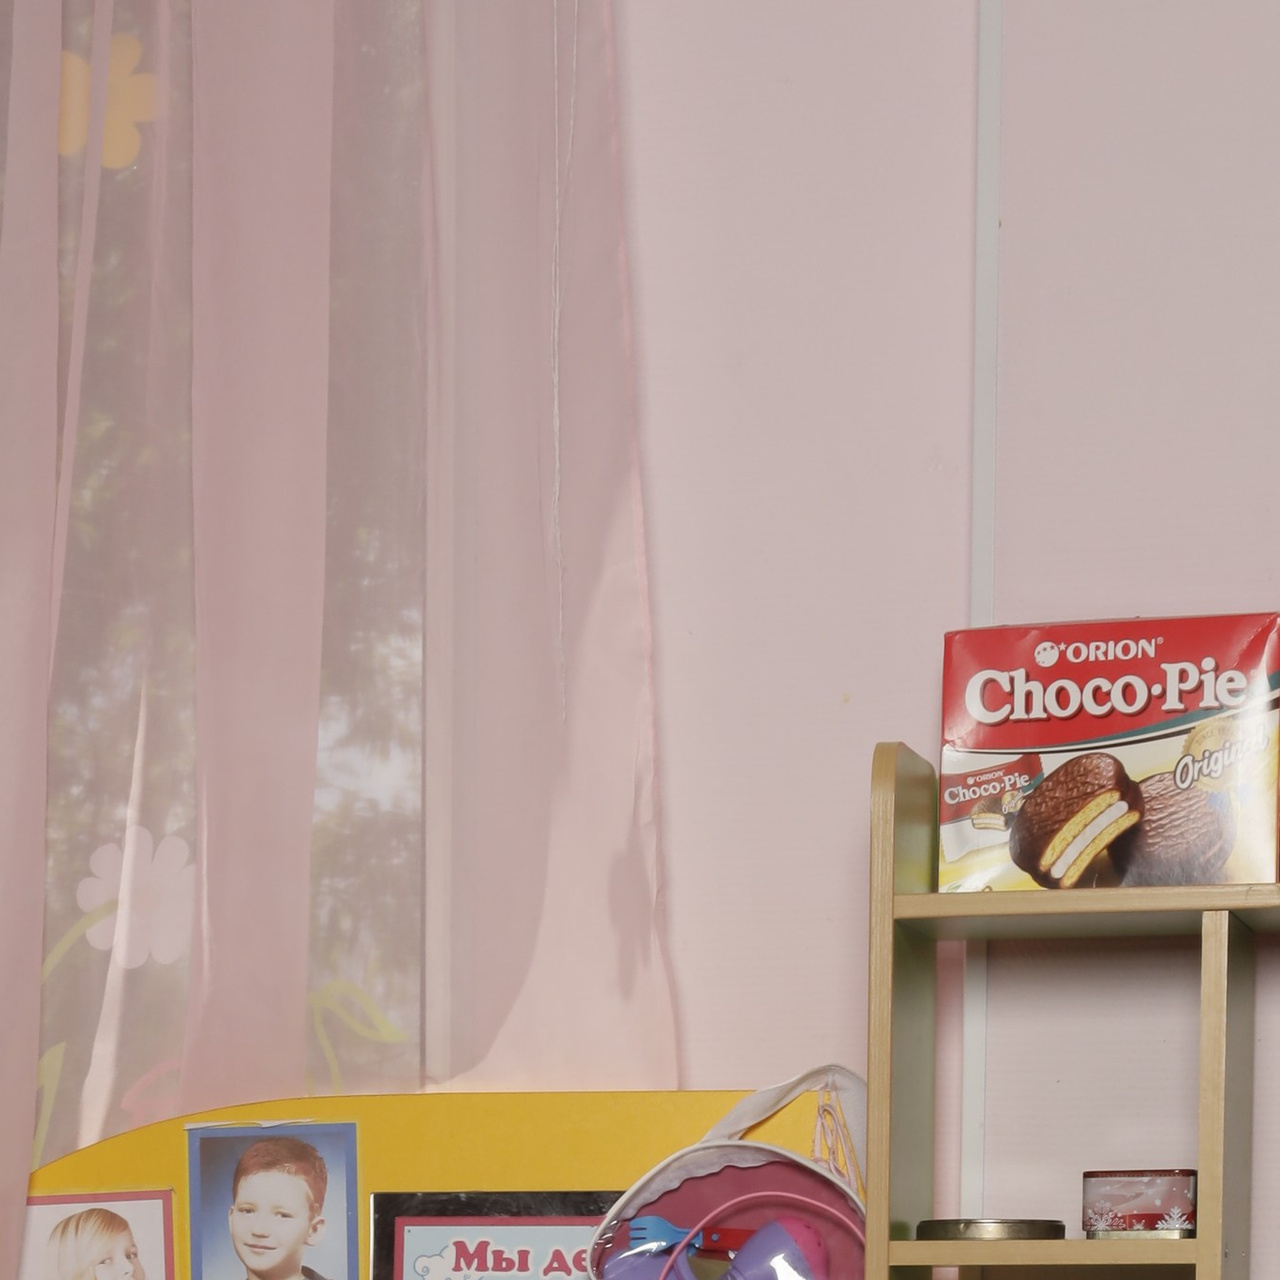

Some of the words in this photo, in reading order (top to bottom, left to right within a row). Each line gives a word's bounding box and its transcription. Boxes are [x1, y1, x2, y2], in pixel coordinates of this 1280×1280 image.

[1066, 637, 1157, 664] ORION
[1174, 724, 1269, 790] Originl
[452, 1240, 530, 1273] Мы
